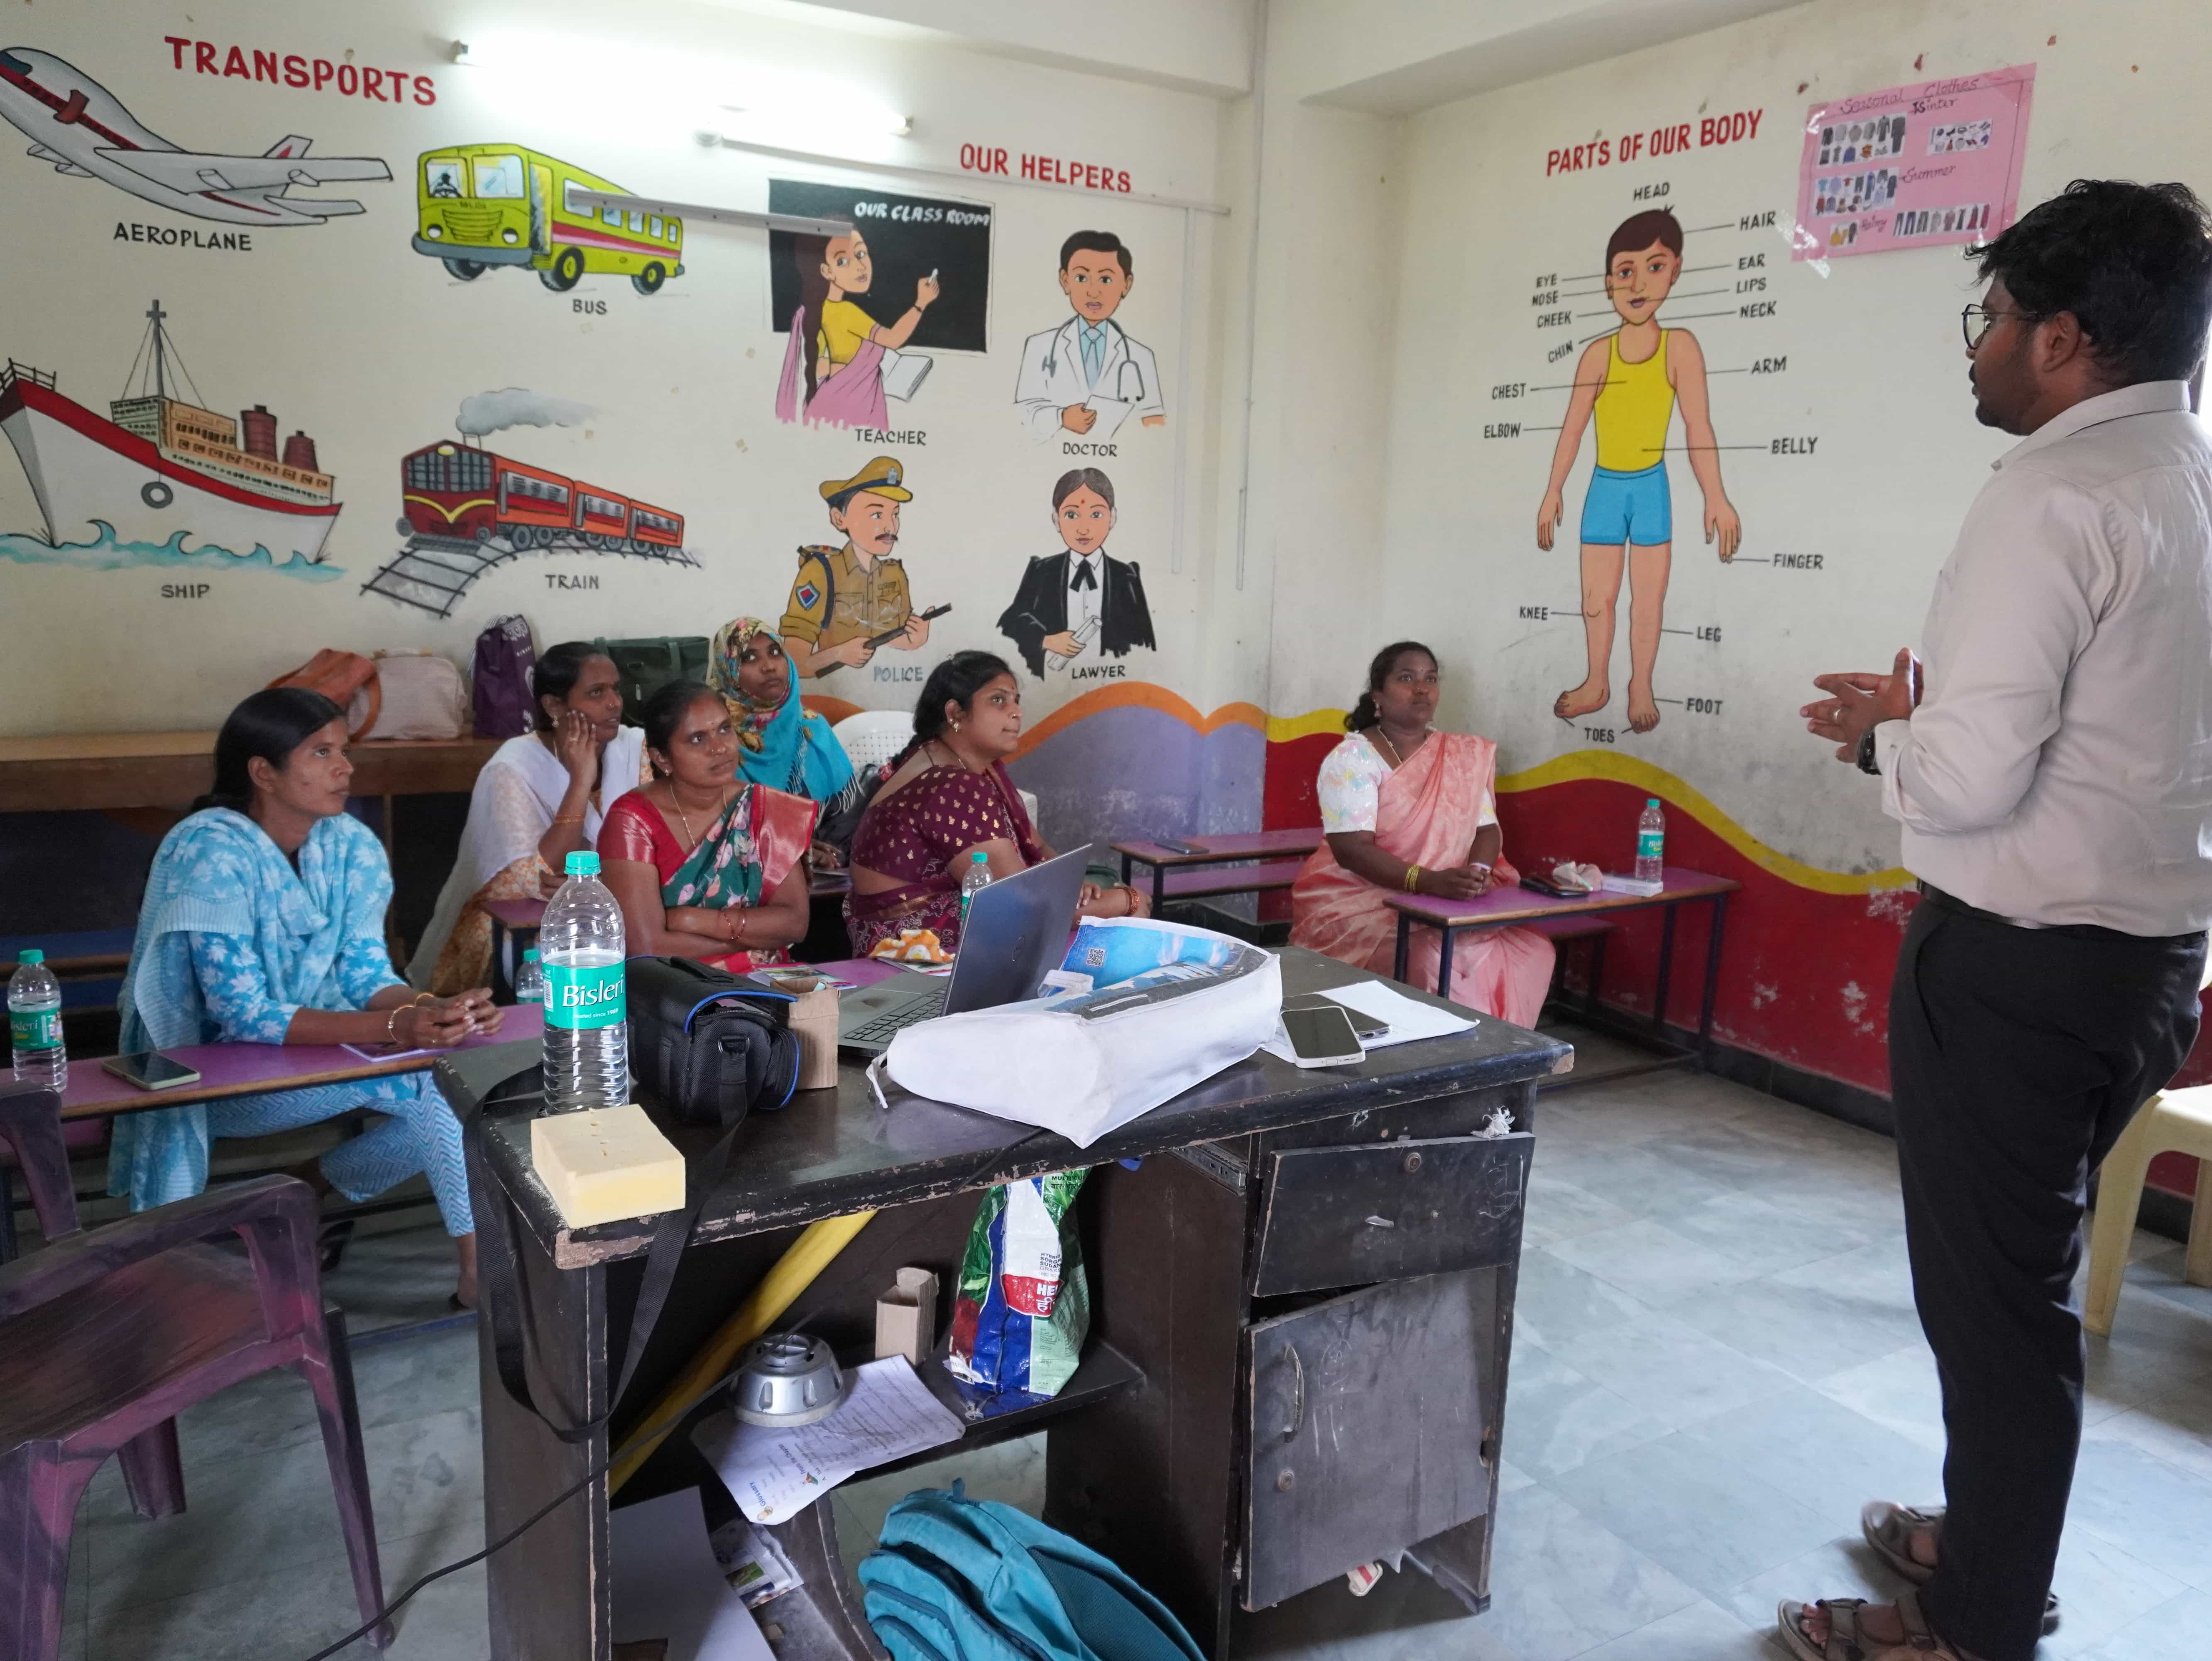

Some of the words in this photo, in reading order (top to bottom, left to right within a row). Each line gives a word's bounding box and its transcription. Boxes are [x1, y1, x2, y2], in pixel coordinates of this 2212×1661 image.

[164, 35, 436, 106] TRANSPORTS
[1840, 88, 1904, 114] Seasonal
[1924, 78, 1979, 98] Clothes
[1546, 142, 1612, 177] PARTS
[1619, 133, 1644, 162] OF
[1649, 122, 1691, 157] OUR
[1700, 108, 1764, 147] BODY
[960, 143, 1009, 175] OUR
[1021, 153, 1132, 193] HELPERS
[1906, 165, 1956, 183] Summer
[1633, 181, 1670, 201] HEAD
[854, 201, 888, 217] OUR
[891, 205, 943, 223] CLASS
[946, 209, 991, 227] ROOM
[1740, 211, 1776, 231] HAIR
[113, 222, 252, 251] AEROPLANE
[1738, 253, 1765, 270] EAR
[1535, 274, 1558, 288] EYE
[1736, 277, 1767, 294] LIPS
[572, 299, 608, 315] BUS
[1532, 291, 1559, 306] NOSE
[1740, 301, 1777, 318] NECK
[1537, 311, 1572, 328] CHEEK
[1547, 341, 1574, 364] CHIN
[1751, 355, 1787, 374] ARM
[1491, 383, 1527, 400] CHEST
[855, 429, 927, 446] TEACHER
[1484, 422, 1521, 439] ELBOW
[1062, 442, 1117, 458] DOCTOR
[1770, 436, 1818, 455] BELLY
[1773, 553, 1824, 570] FINGER
[544, 574, 600, 590] TRAIN
[161, 583, 210, 599] SHIP
[1519, 606, 1548, 621] KNEE
[1696, 626, 1722, 642] LEG
[873, 666, 923, 682] POLICE
[1072, 665, 1126, 679] LAWYER
[1686, 698, 1723, 715] FOOT
[1584, 727, 1615, 743] TOES
[563, 973, 624, 1007] Bisleri
[749, 1482, 766, 1507] Glossary
